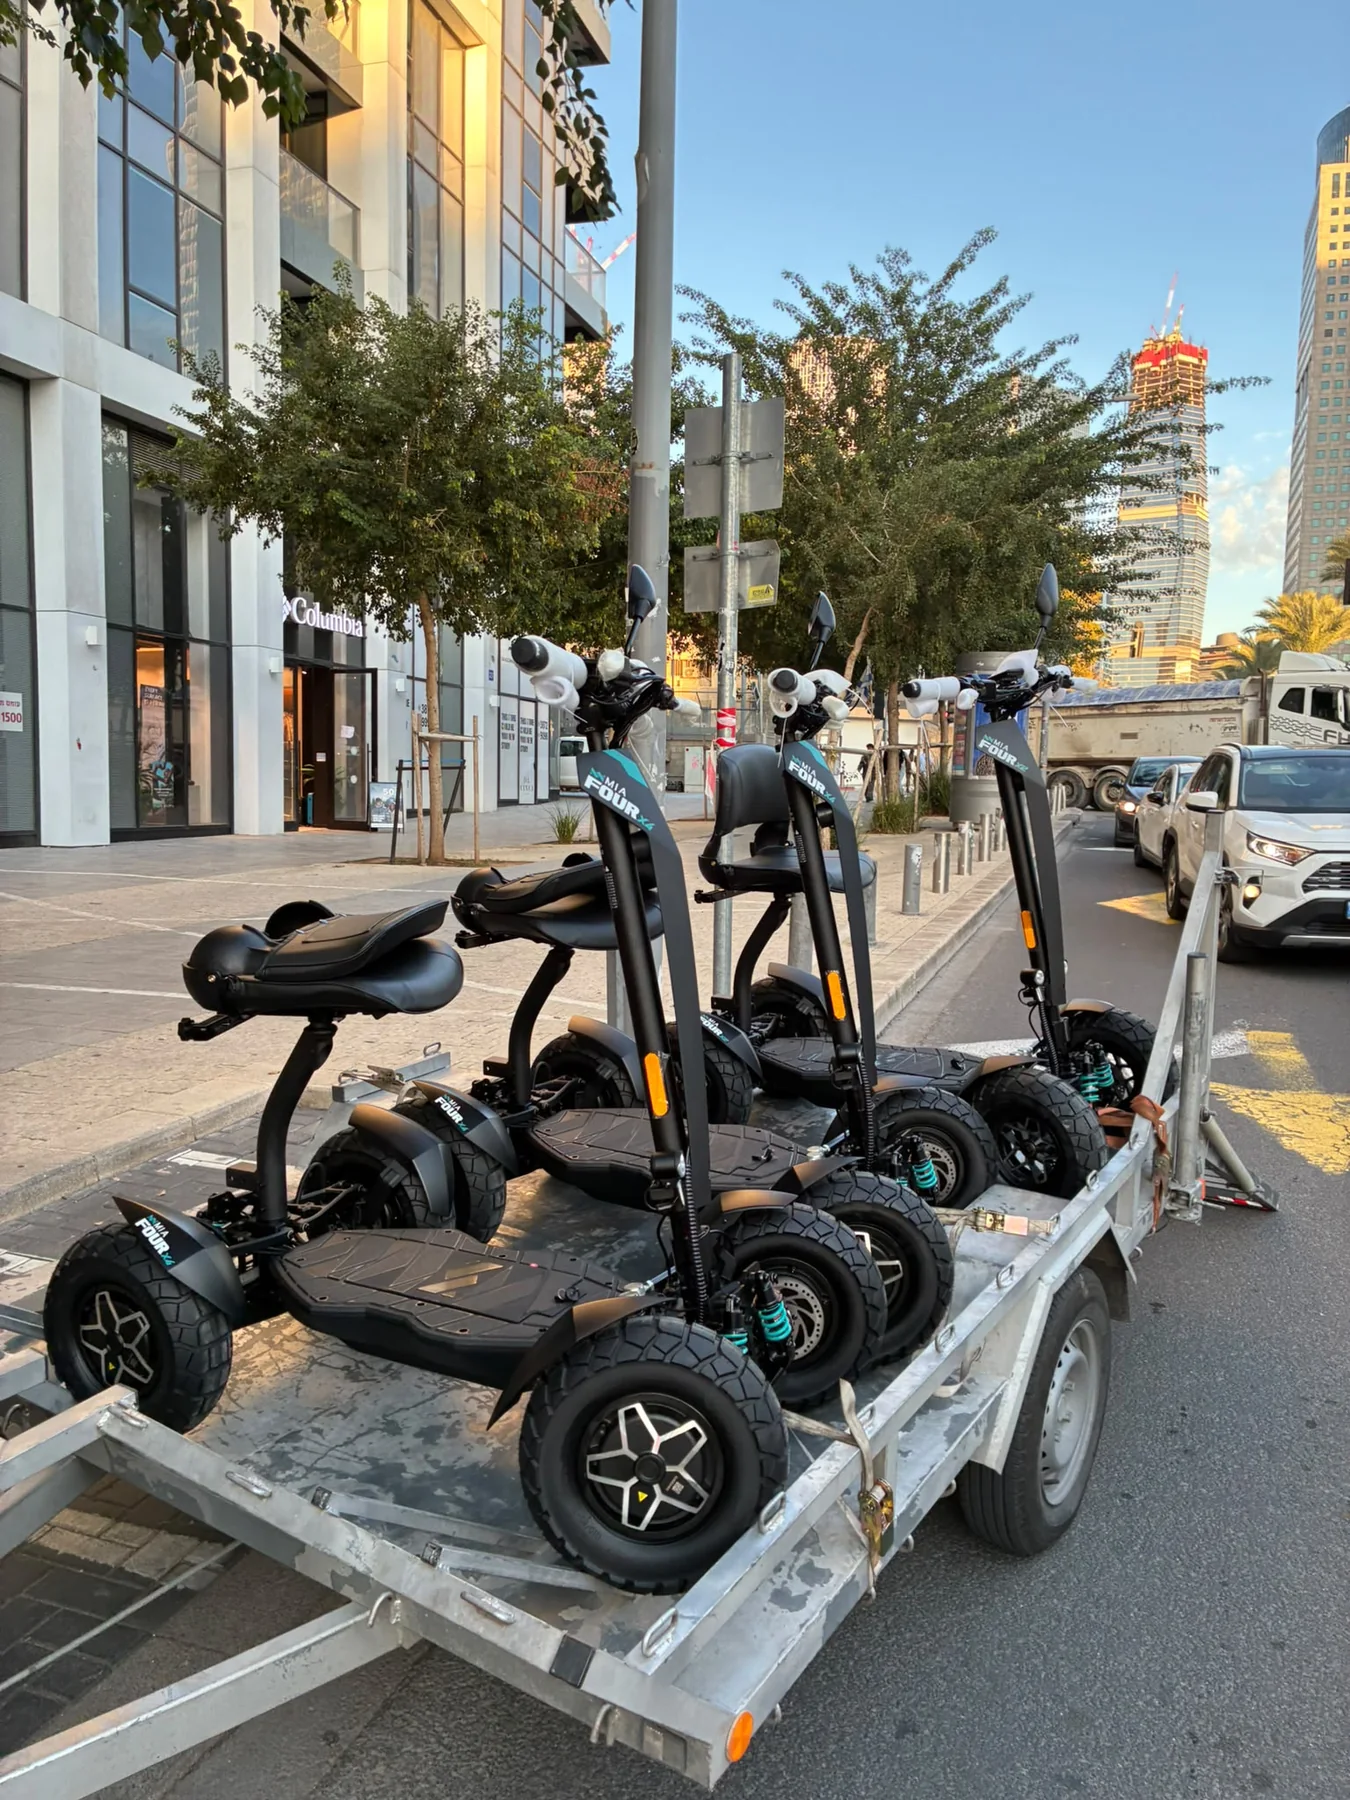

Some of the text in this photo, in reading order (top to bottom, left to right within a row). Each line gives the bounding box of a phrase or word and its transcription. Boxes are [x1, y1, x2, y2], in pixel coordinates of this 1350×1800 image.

[291, 597, 363, 637] Columbia
[1, 711, 22, 723] 1500
[978, 738, 1018, 766] FOUR
[993, 739, 1009, 752] MIA
[788, 760, 827, 795] FOUR
[801, 761, 817, 777] MIA
[584, 775, 640, 820] FOUR
[604, 776, 627, 797] MIA
[434, 1096, 464, 1124] FOUR
[134, 1217, 170, 1256] FOUR
[154, 1221, 170, 1238] MIA
